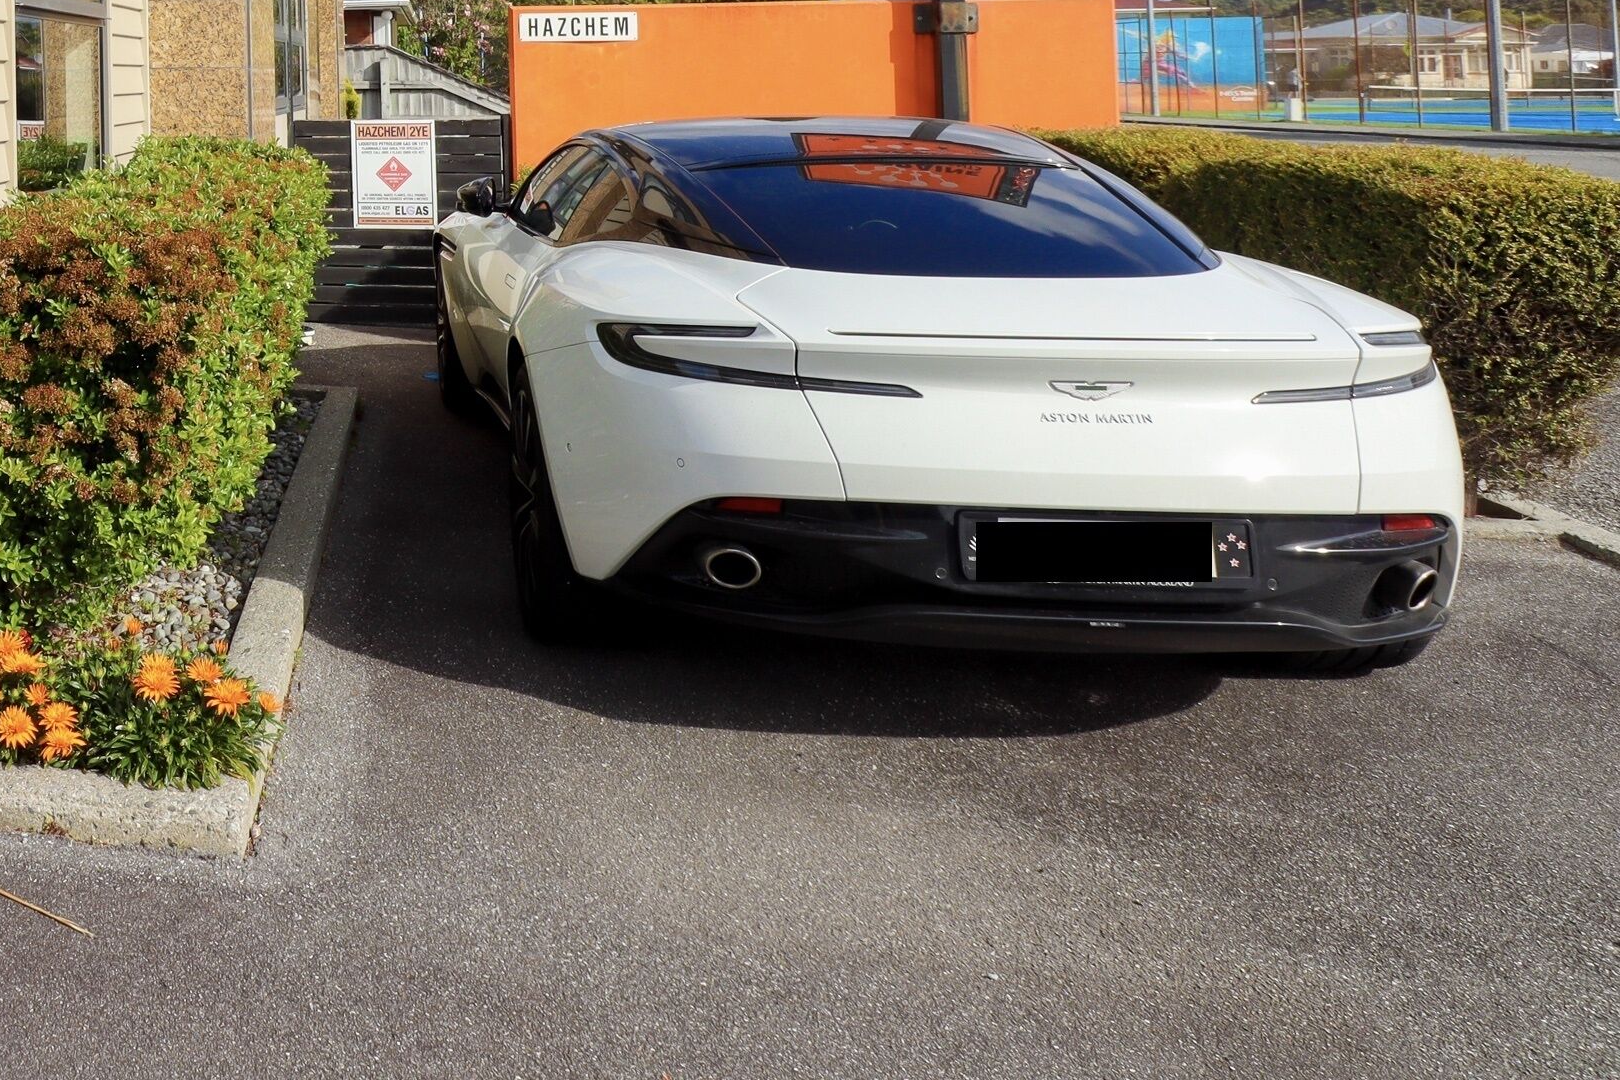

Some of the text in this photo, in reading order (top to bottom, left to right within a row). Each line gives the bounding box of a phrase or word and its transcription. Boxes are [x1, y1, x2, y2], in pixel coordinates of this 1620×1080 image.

[527, 16, 630, 37] HAZCHEM
[358, 126, 429, 138] HAZCHEM 2YE
[394, 205, 429, 216] ELGAS
[1039, 412, 1154, 424] ASTON MARTIN
